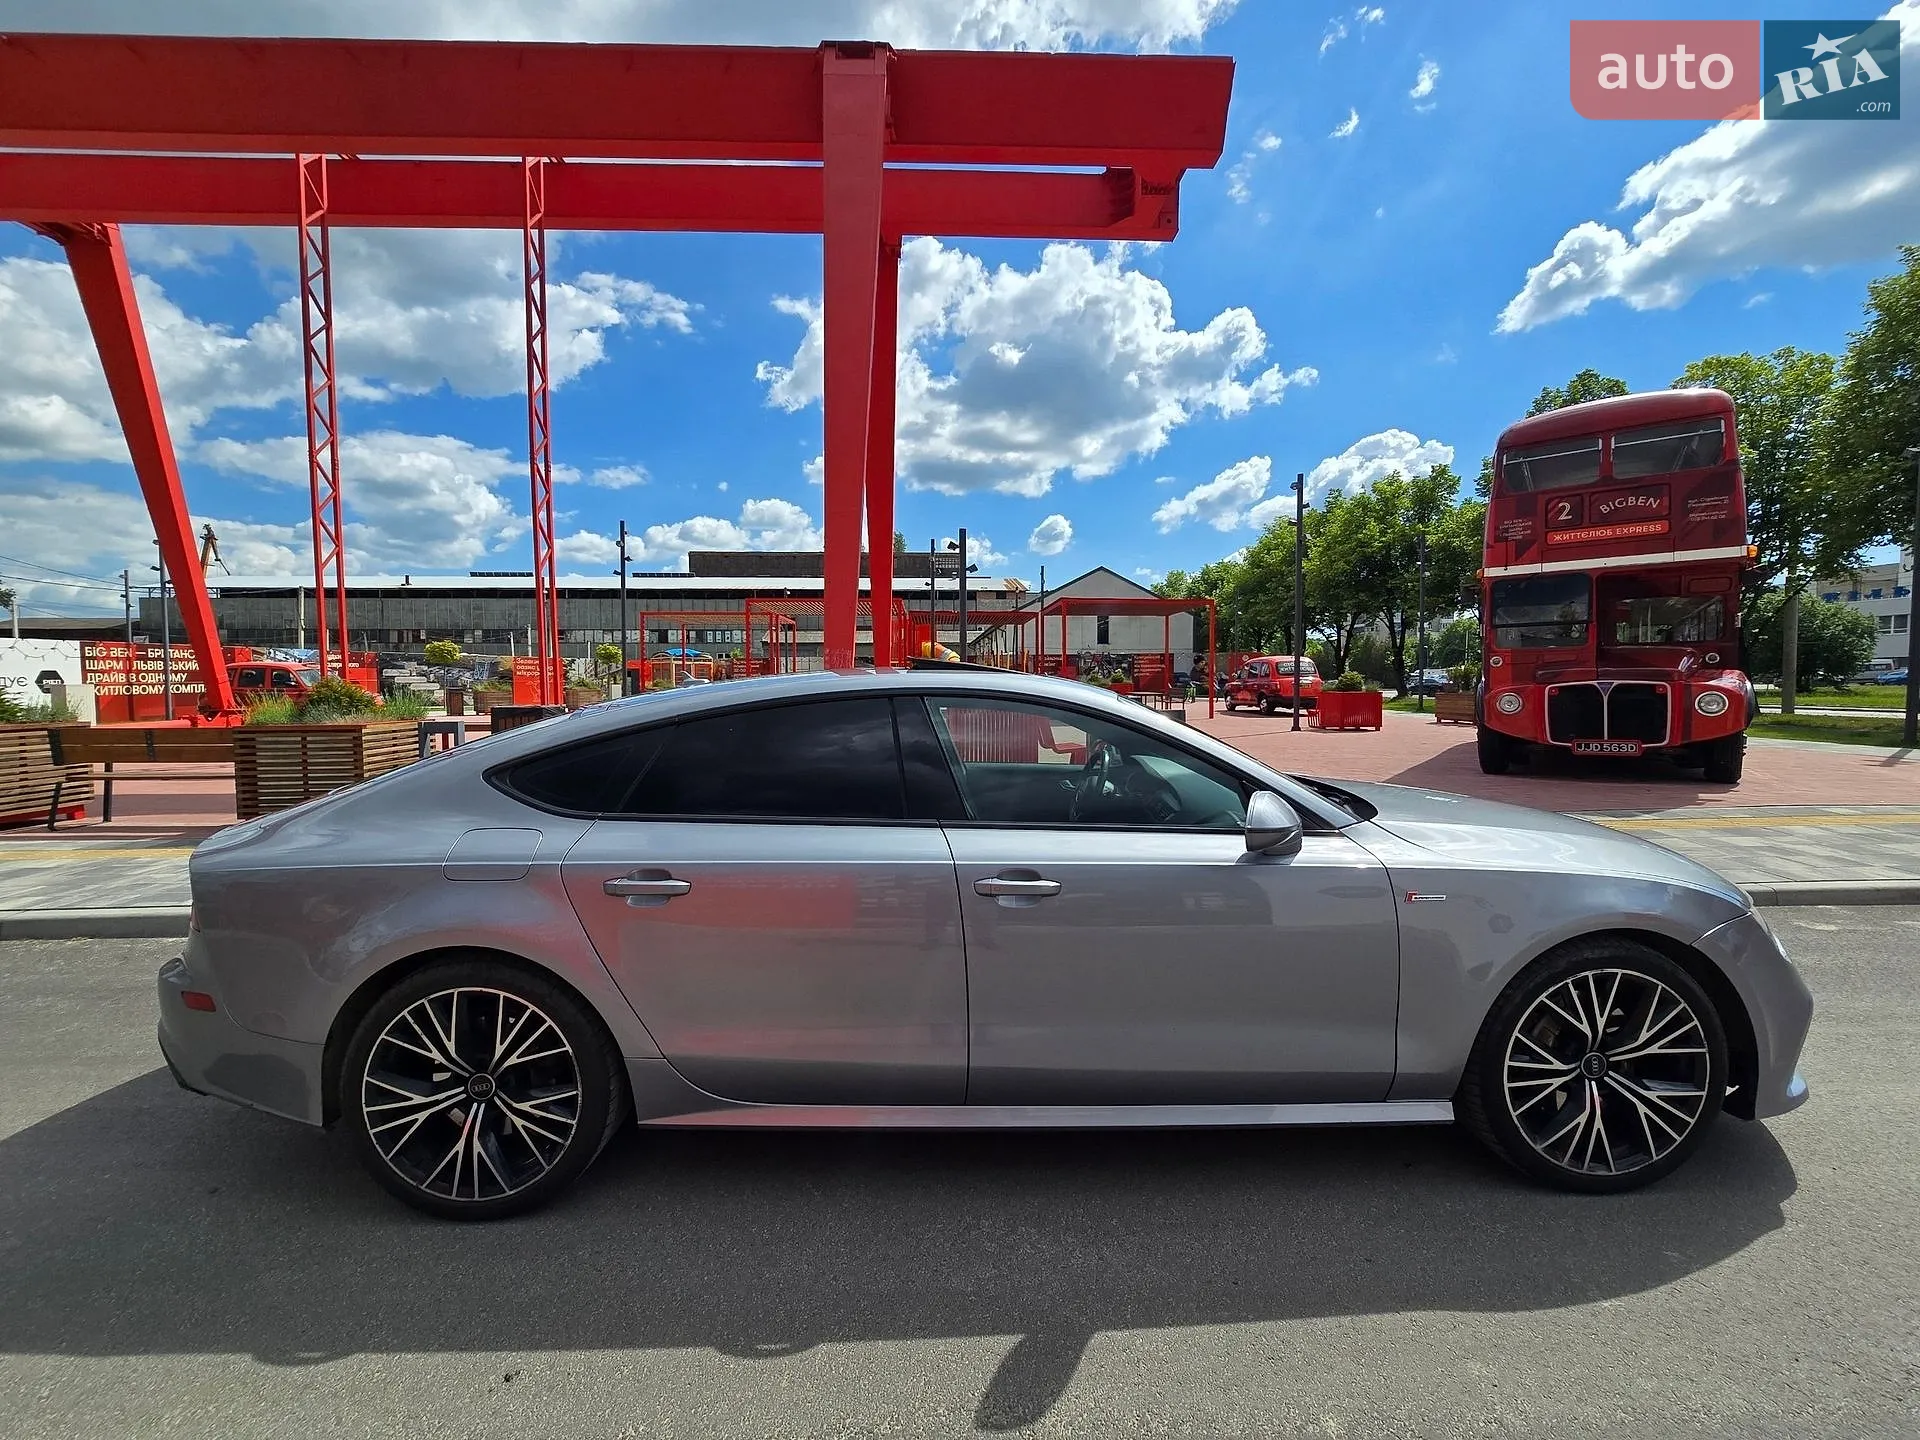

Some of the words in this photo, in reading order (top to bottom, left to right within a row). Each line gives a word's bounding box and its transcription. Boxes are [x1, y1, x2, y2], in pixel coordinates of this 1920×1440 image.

[1557, 502, 1573, 521] 2
[1599, 495, 1660, 514] BIGBEN
[1553, 529, 1613, 541] ЖИТТЄЛЮБ
[1616, 524, 1662, 535] EXPRESS
[109, 647, 133, 658] BEN
[85, 659, 123, 670] ШАРМ
[86, 671, 126, 684] ДРАЙВ
[129, 673, 136, 683] В
[168, 683, 207, 694] КОМПЛ
[1577, 743, 1601, 752] JJD
[1602, 743, 1637, 752] 563D
